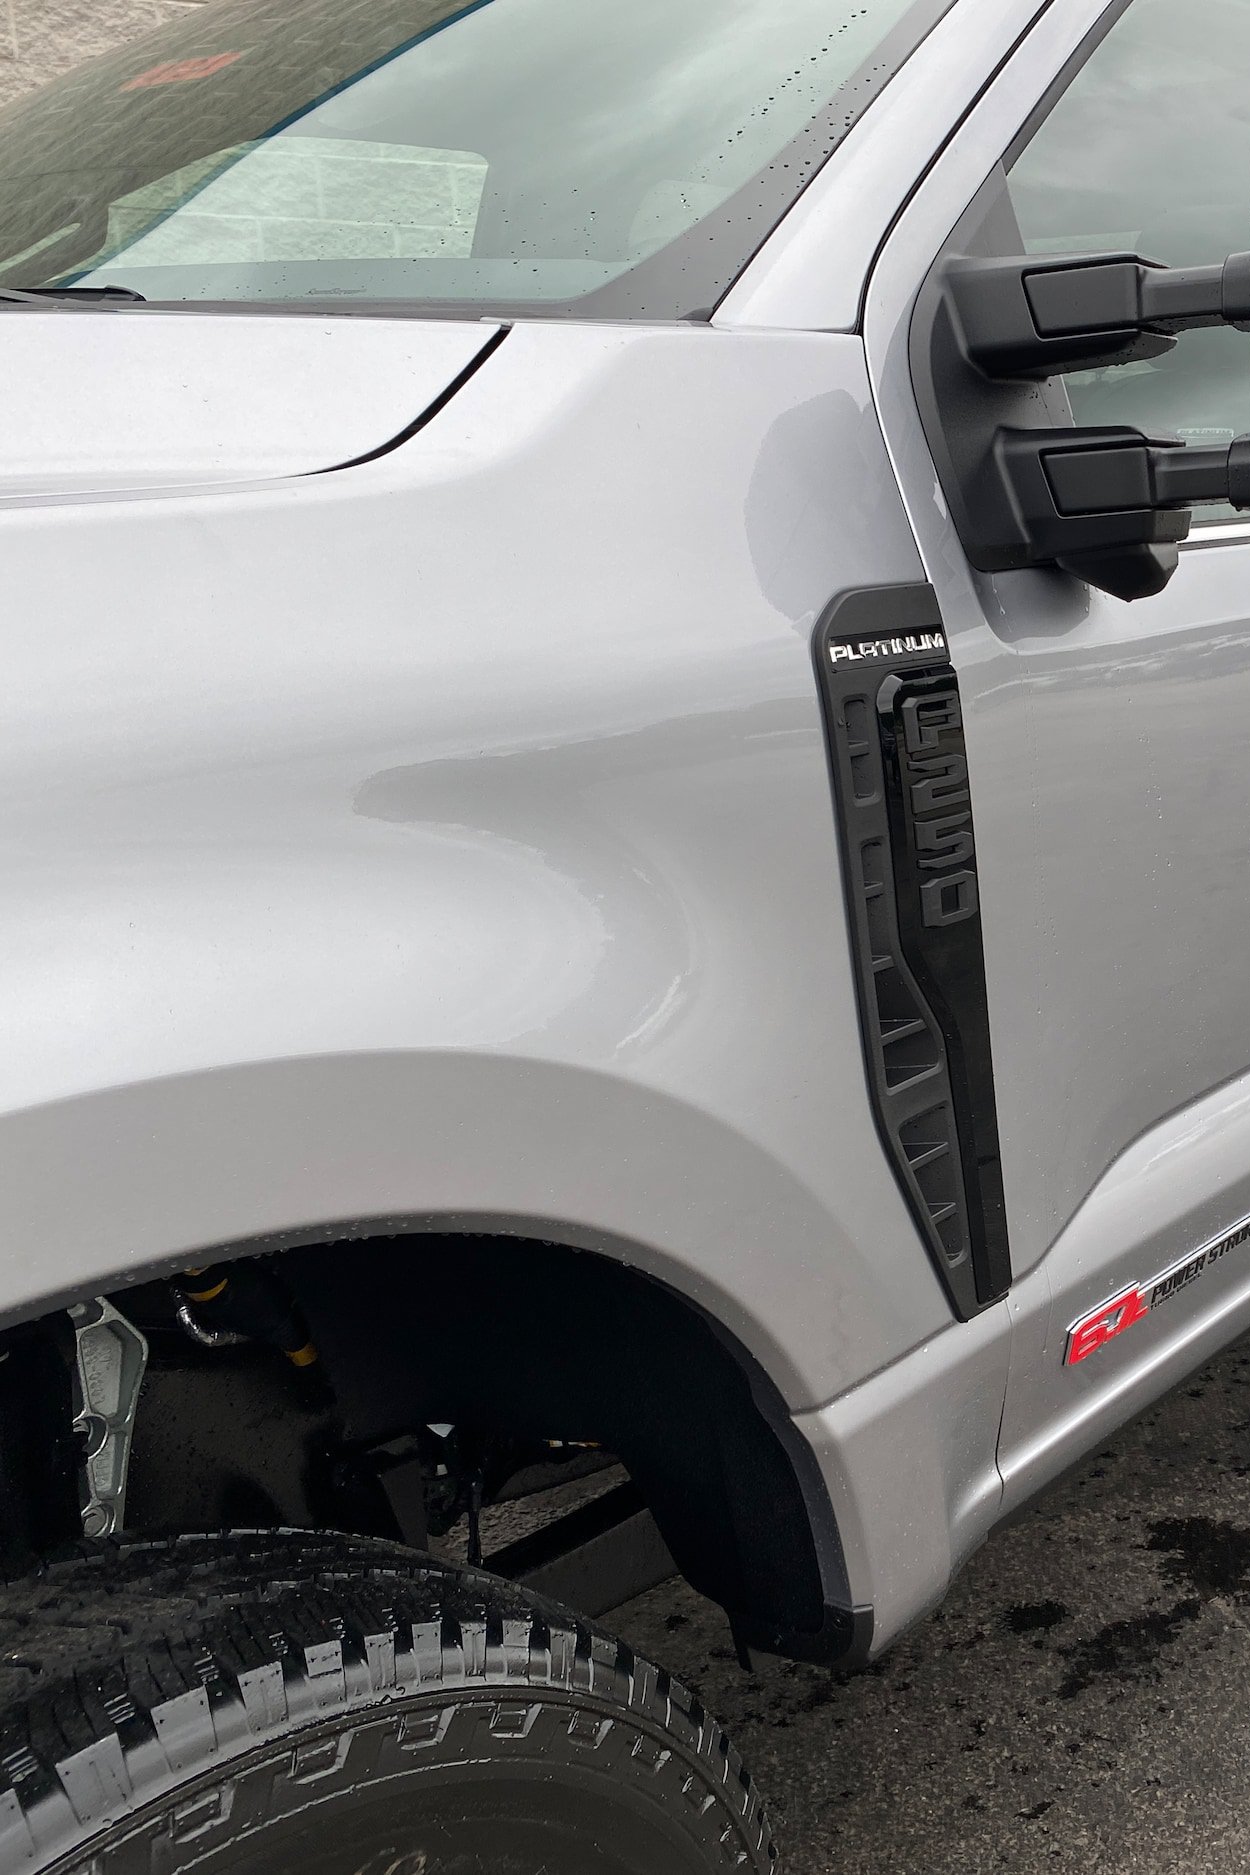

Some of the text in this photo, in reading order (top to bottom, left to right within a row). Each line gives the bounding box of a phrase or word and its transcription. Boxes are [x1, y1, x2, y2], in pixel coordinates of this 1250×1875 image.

[830, 632, 945, 663] PLATINUM
[901, 689, 979, 928] F250
[1151, 1253, 1206, 1304] POWER
